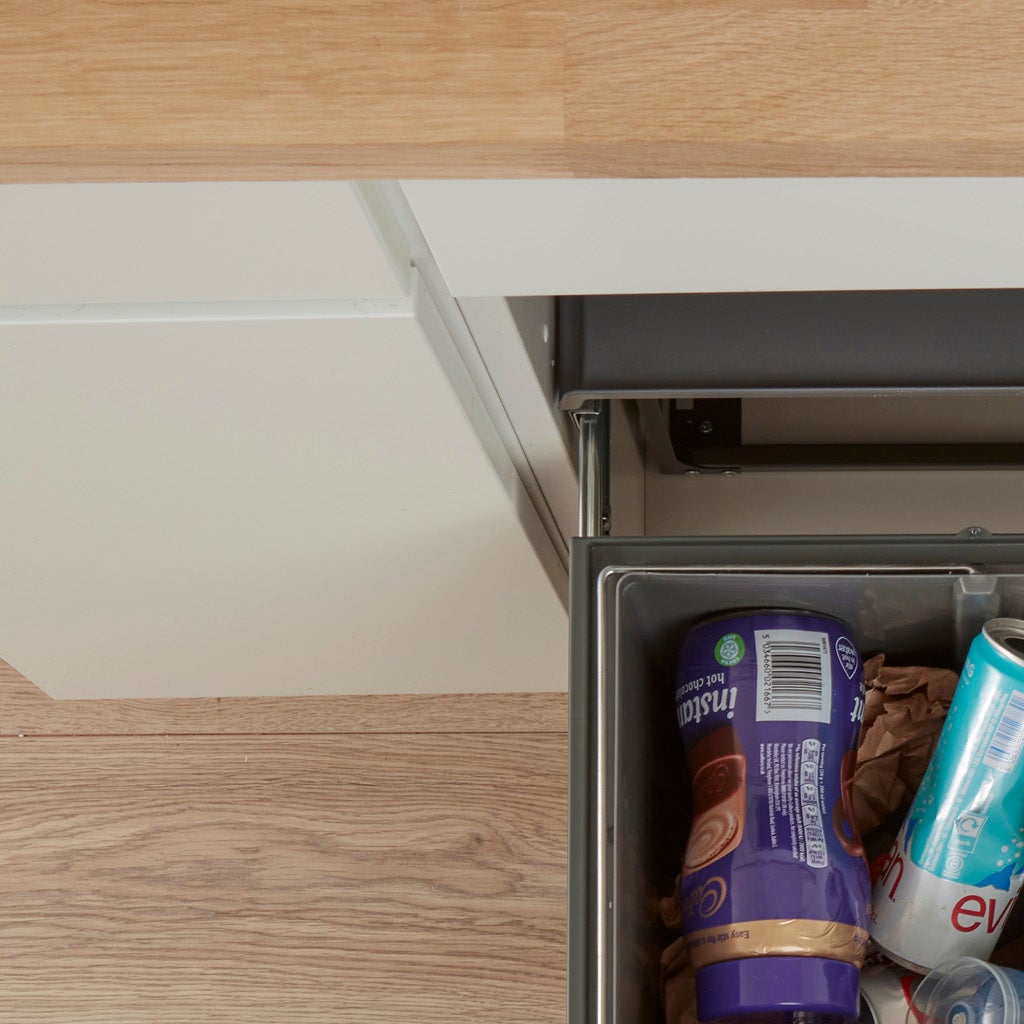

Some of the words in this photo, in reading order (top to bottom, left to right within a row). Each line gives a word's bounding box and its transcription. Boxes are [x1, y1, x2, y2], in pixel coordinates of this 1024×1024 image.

[763, 642, 771, 674] 034660
[706, 672, 724, 684] hot
[763, 674, 771, 710] 021667
[731, 930, 749, 939] Easy
